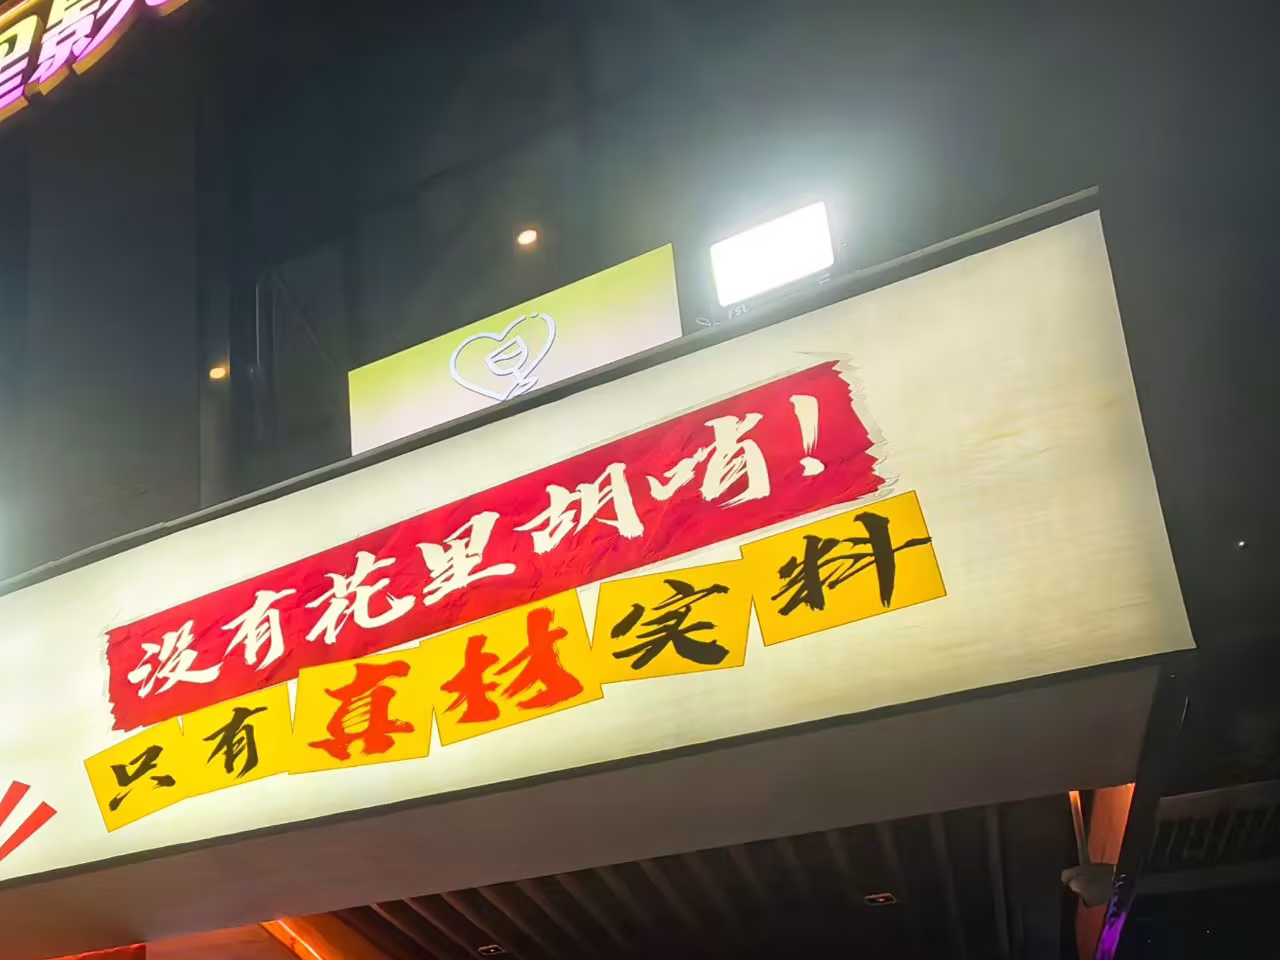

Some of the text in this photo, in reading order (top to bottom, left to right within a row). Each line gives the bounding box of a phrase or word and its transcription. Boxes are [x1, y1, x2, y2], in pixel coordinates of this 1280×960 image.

[107, 510, 932, 812] 只有真材实料
